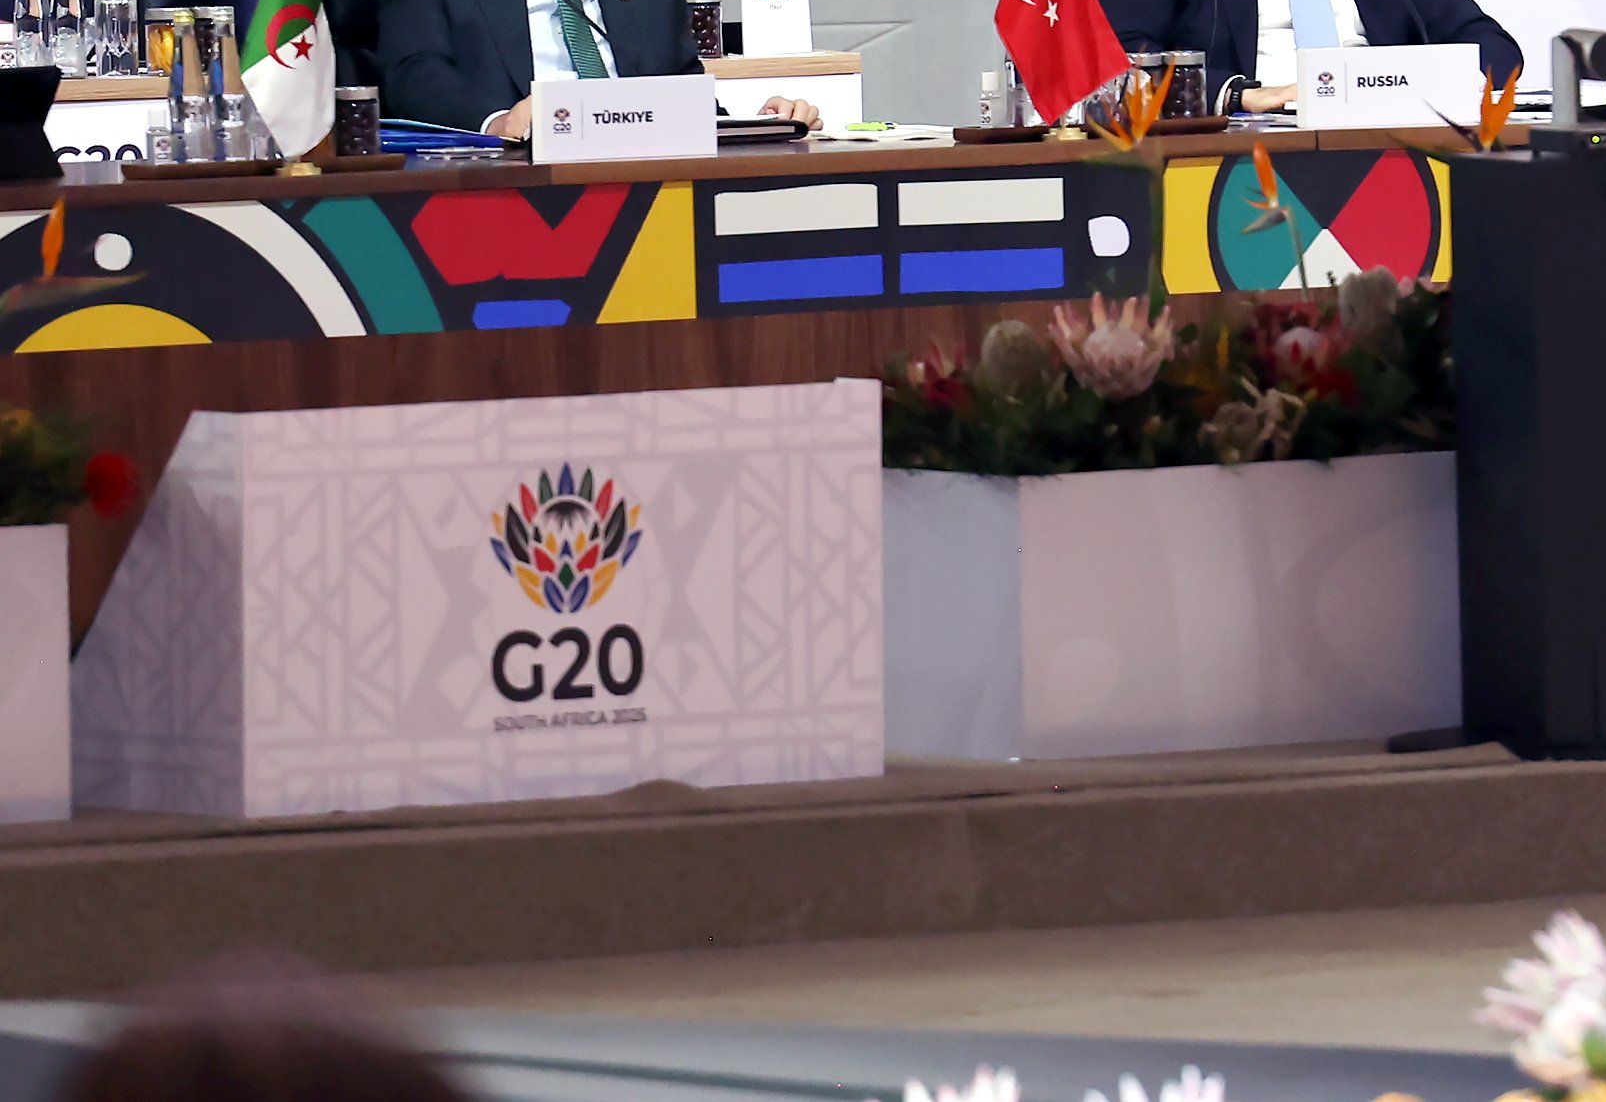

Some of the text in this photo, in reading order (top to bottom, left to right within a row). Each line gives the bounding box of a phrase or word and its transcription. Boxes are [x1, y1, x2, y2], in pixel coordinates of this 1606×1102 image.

[1357, 75, 1409, 88] RUSSIA
[1317, 86, 1336, 95] G20
[492, 623, 644, 702] G20
